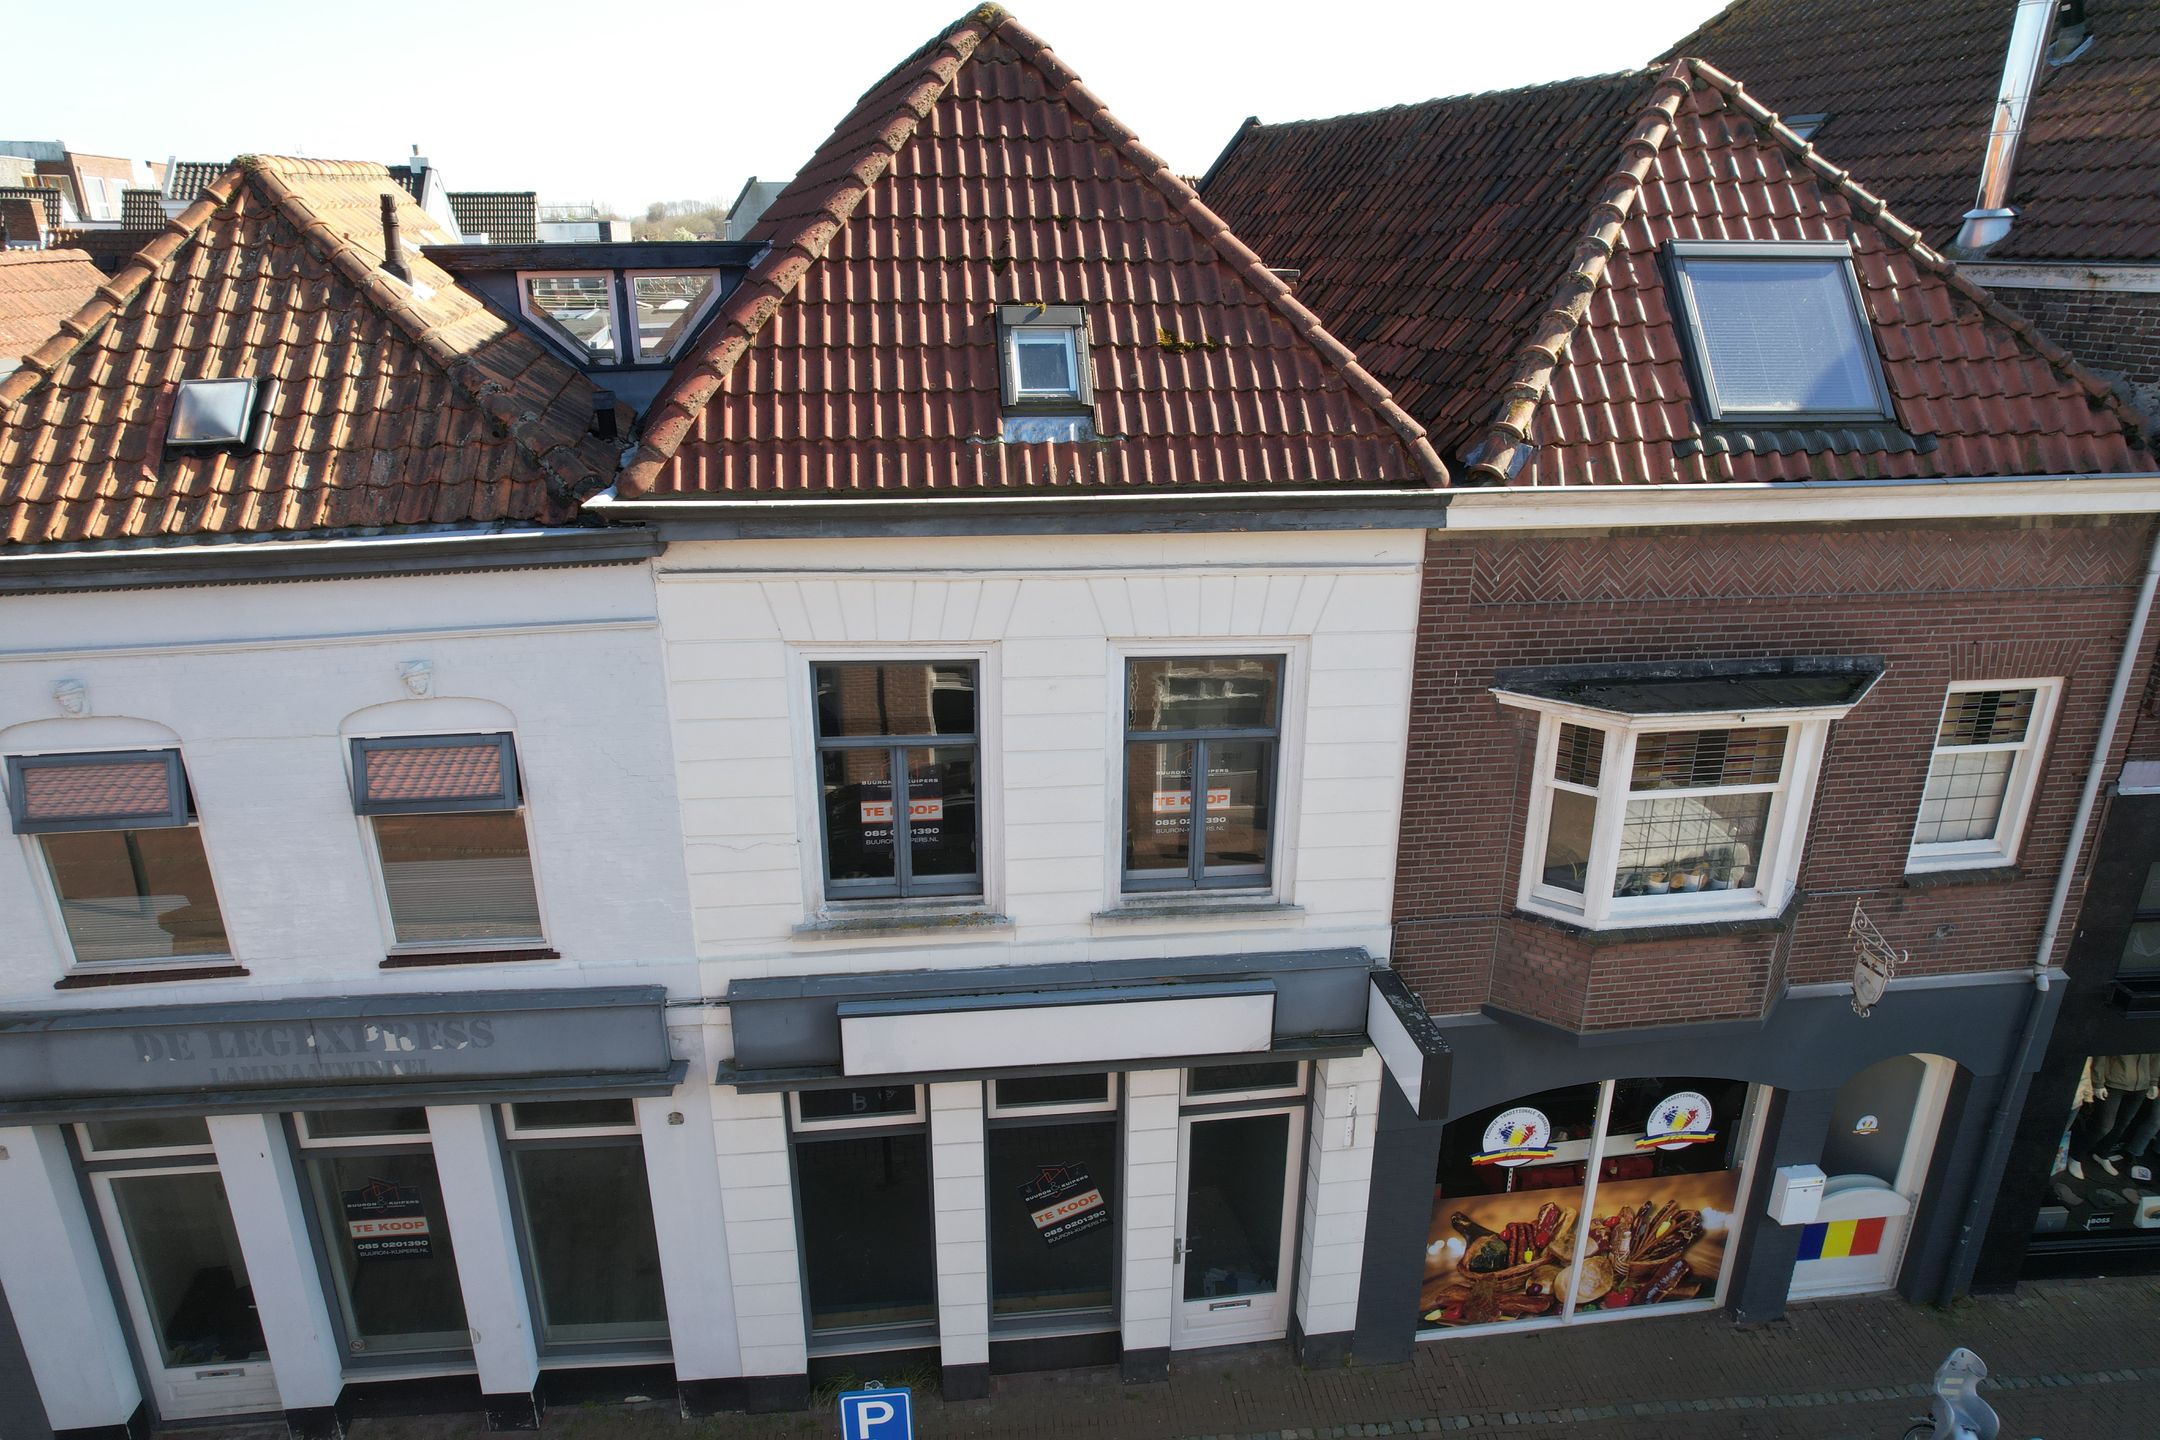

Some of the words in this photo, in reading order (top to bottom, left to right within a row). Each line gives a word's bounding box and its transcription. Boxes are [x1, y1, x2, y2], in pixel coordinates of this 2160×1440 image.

[1155, 796, 1175, 806] TE
[1181, 794, 1228, 806] KOP
[863, 807, 884, 817] TE
[1155, 818, 1176, 826] 085
[864, 829, 887, 837] 085
[130, 1032, 196, 1062] DE
[206, 1018, 495, 1059] LEGEXPRESS
[1035, 1211, 1055, 1223] TE
[1057, 1194, 1098, 1215] KOOP
[353, 1224, 374, 1233] TE
[378, 1221, 425, 1231] KOOP
[1044, 1227, 1063, 1238] 085
[1064, 1210, 1106, 1230] 0201390
[381, 1240, 428, 1248] 0201390
[857, 1401, 895, 1440] P
